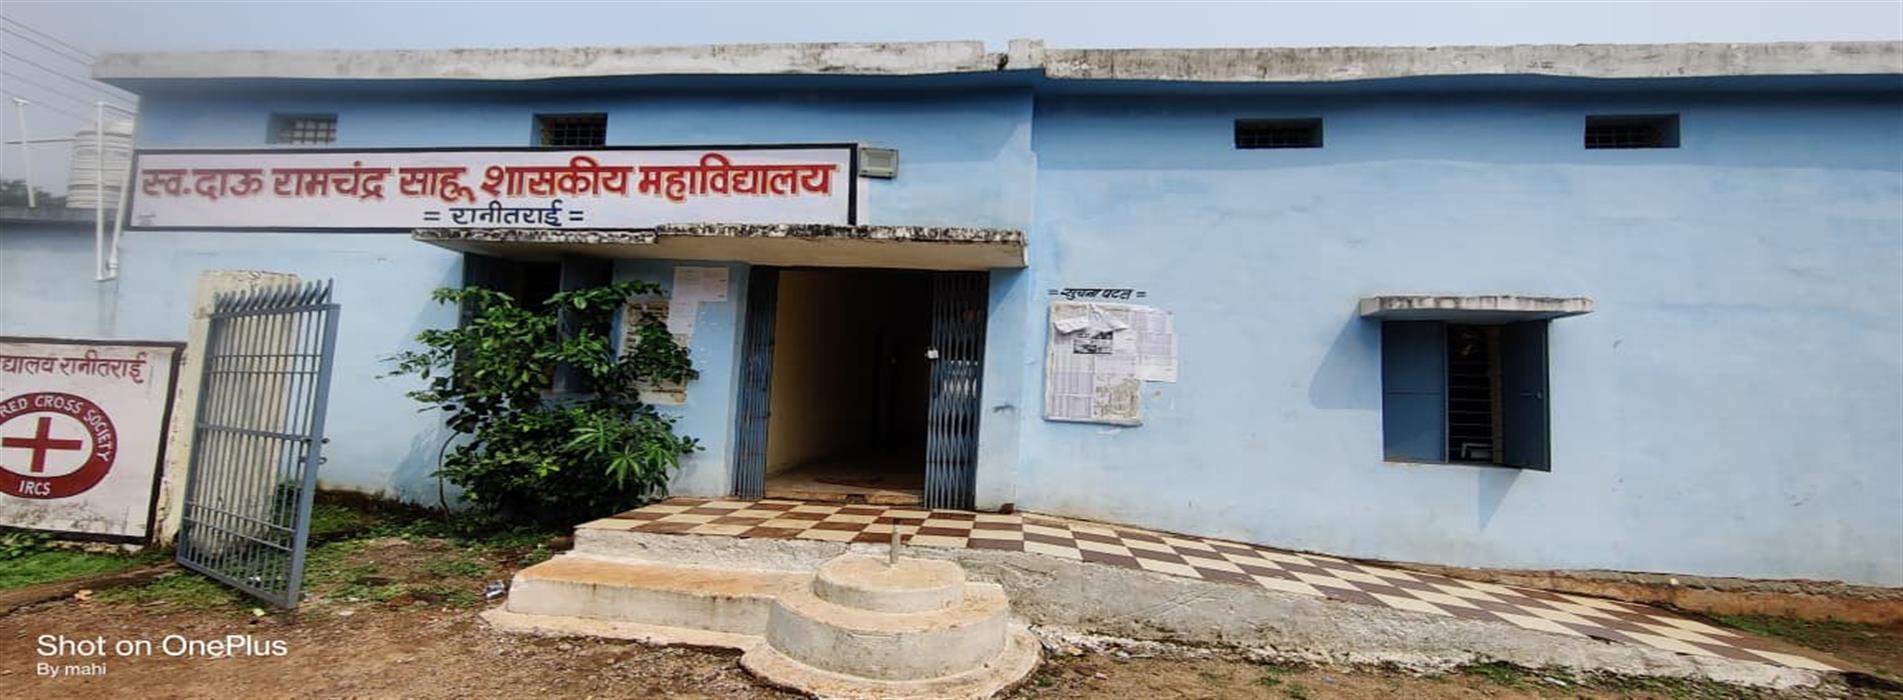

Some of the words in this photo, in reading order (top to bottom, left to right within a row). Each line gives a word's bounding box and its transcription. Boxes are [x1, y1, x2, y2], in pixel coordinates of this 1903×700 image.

[270, 161, 392, 200] रामचंद्र
[399, 167, 477, 203] साहू
[480, 155, 634, 199] शासकीय
[638, 153, 836, 203] महाविद्यालय
[449, 199, 563, 227] रानीतराई
[60, 349, 147, 383] रानीतराई
[0, 398, 28, 416] RED
[34, 395, 84, 414] CROSS
[83, 409, 111, 462] SOCIETY
[18, 479, 52, 497] IRCS
